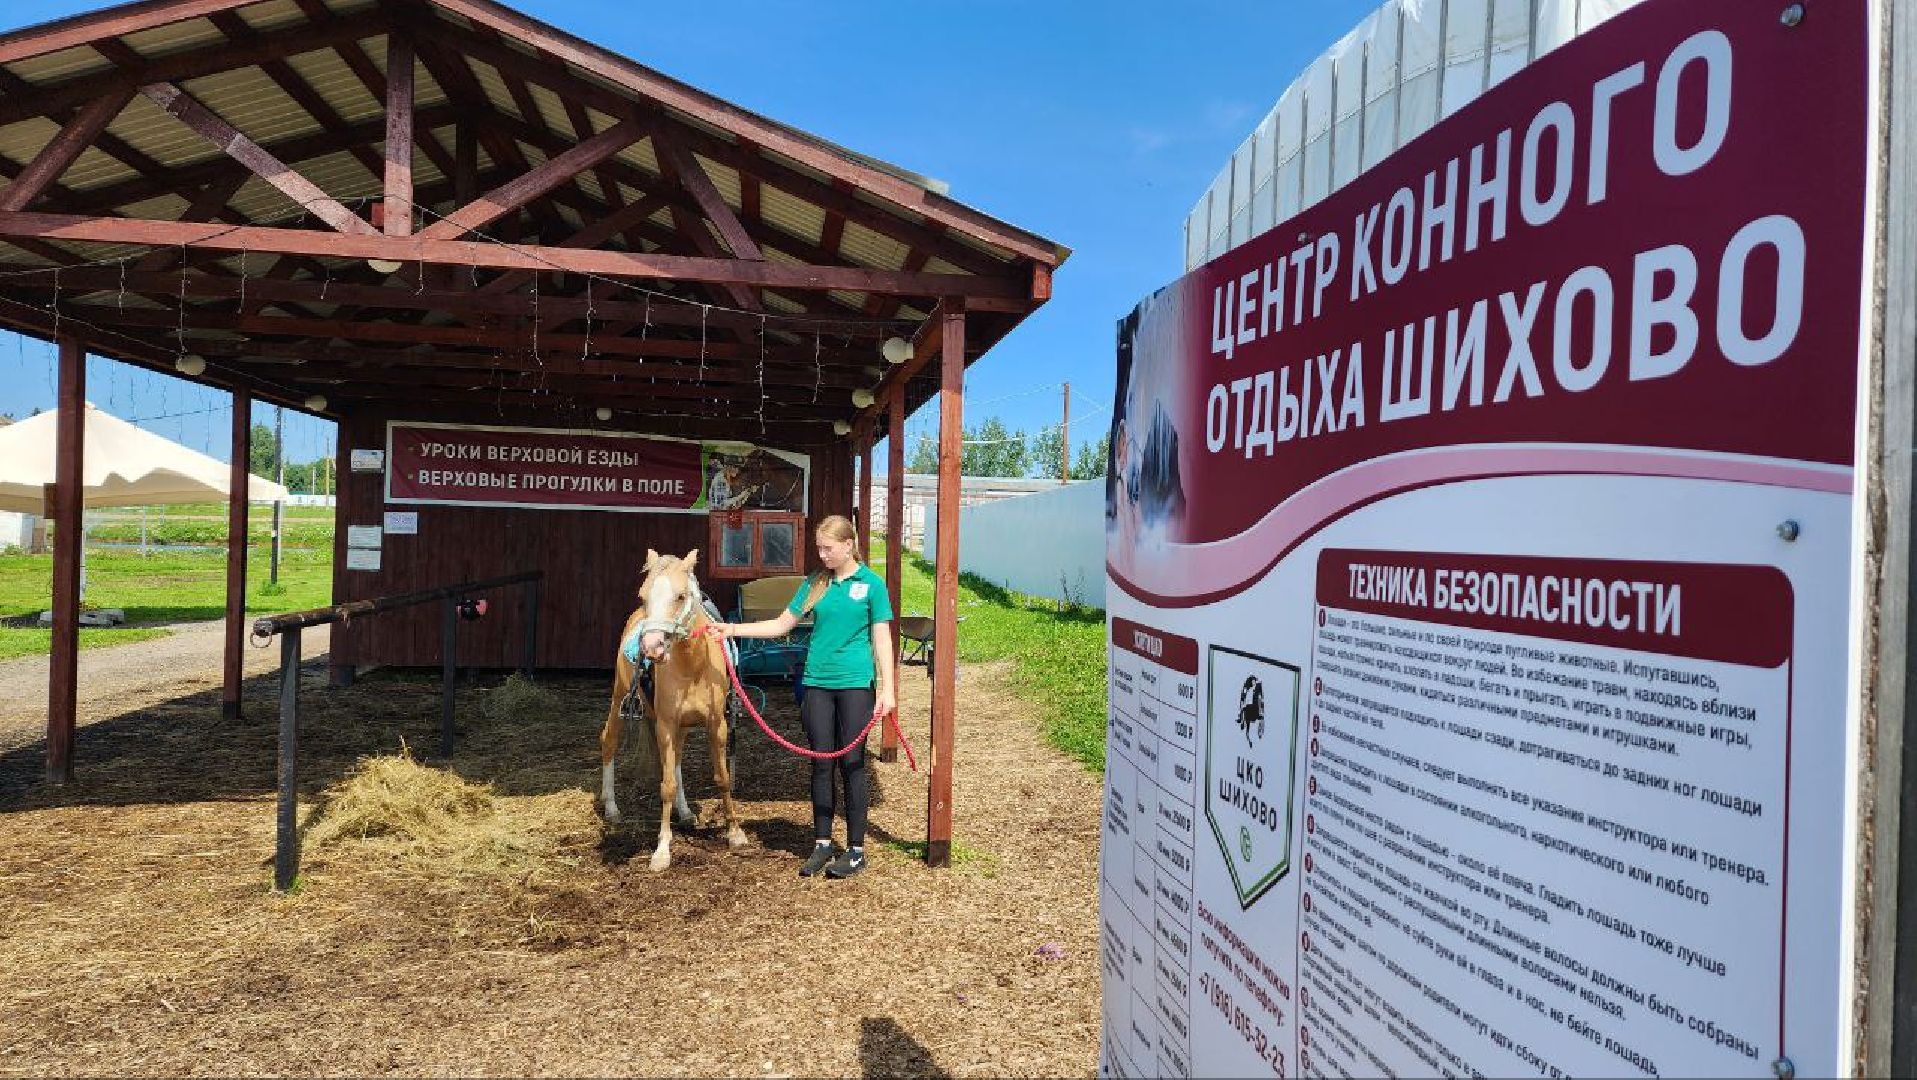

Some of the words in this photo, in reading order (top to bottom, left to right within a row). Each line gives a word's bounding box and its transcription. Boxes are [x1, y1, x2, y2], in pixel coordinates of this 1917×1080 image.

[1211, 231, 1340, 360] ЦЕНТР
[1350, 29, 1734, 302] КОННОГО
[1205, 341, 1366, 459] ОТДЫХА
[1379, 214, 1807, 423] ШИХОВО
[418, 469, 517, 490] ВЕРХОВЫЕ
[523, 474, 617, 493] ПРОГУЛКИ
[622, 477, 633, 493] В
[638, 479, 685, 496] ПОЛЕ
[420, 442, 482, 461] УРОКИ
[487, 443, 583, 466] ВЕРХОВОЙ
[588, 449, 639, 467] ЕЗДЫ
[1348, 563, 1428, 606] ТЕХНИКА
[1433, 569, 1682, 637] БЕЗОПАСНОСТИ
[1443, 654, 1473, 672] вокруг
[1510, 662, 1525, 679] Во
[1526, 668, 1589, 690] избежание
[1591, 680, 1631, 701] травм,
[1633, 688, 1698, 711] находясь
[1701, 697, 1756, 721] вблизи
[1462, 637, 1503, 657] природе
[1505, 644, 1555, 663] пугливые
[1558, 653, 1620, 674] животные.
[1623, 659, 1719, 692] Испугавшись,
[1457, 695, 1518, 718] различными
[1520, 709, 1590, 734] предметами
[1602, 727, 1678, 755] игрушками.
[1478, 677, 1512, 697] бегать
[1522, 689, 1569, 710] прыгать,
[1572, 698, 1612, 718] играть
[1613, 706, 1622, 720] в
[1625, 710, 1705, 736] подвижные
[1710, 726, 1752, 749] игры,
[1220, 778, 1276, 832] ШИХОВО
[1237, 756, 1263, 789] ЦКО
[1447, 722, 1483, 741] лошади
[1519, 741, 1600, 772] дотрагиваться
[1602, 762, 1620, 778] до
[1622, 768, 1670, 791] задних
[1673, 780, 1698, 798] ног
[1701, 789, 1762, 817] лошади
[1510, 789, 1530, 806] все
[1531, 798, 1585, 823] указания
[1587, 815, 1667, 852] инструктора
[1671, 841, 1698, 862] или
[1702, 851, 1768, 886] тренера.
[1531, 831, 1624, 873] наркотического
[1628, 864, 1653, 885] или
[1656, 875, 1709, 906] любого
[1504, 893, 1550, 925] тренера.
[1538, 884, 1584, 916] Гладить
[1586, 908, 1636, 939] лошадь
[1640, 930, 1674, 955] тоже
[1677, 946, 1726, 977] лучше
[1197, 900, 1214, 926] Всю
[1261, 963, 1290, 1000] можно
[1198, 971, 1210, 995] +7
[1210, 978, 1233, 1024] (916)
[1234, 1007, 1285, 1077] 615-32-23
[1492, 919, 1542, 955] Длинные
[1543, 946, 1589, 978] волосы
[1591, 970, 1645, 1005] должны
[1647, 993, 1684, 1024] быть
[1688, 1016, 1759, 1059] собраны
[1520, 957, 1577, 995] волосами
[1579, 987, 1626, 1020] нельзя.
[1515, 1044, 1548, 1074] сбоку
[1525, 994, 1548, 1017] нос,
[1549, 1007, 1564, 1025] не
[1567, 1014, 1603, 1045] бейте
[1605, 1038, 1659, 1077] лошадь,
